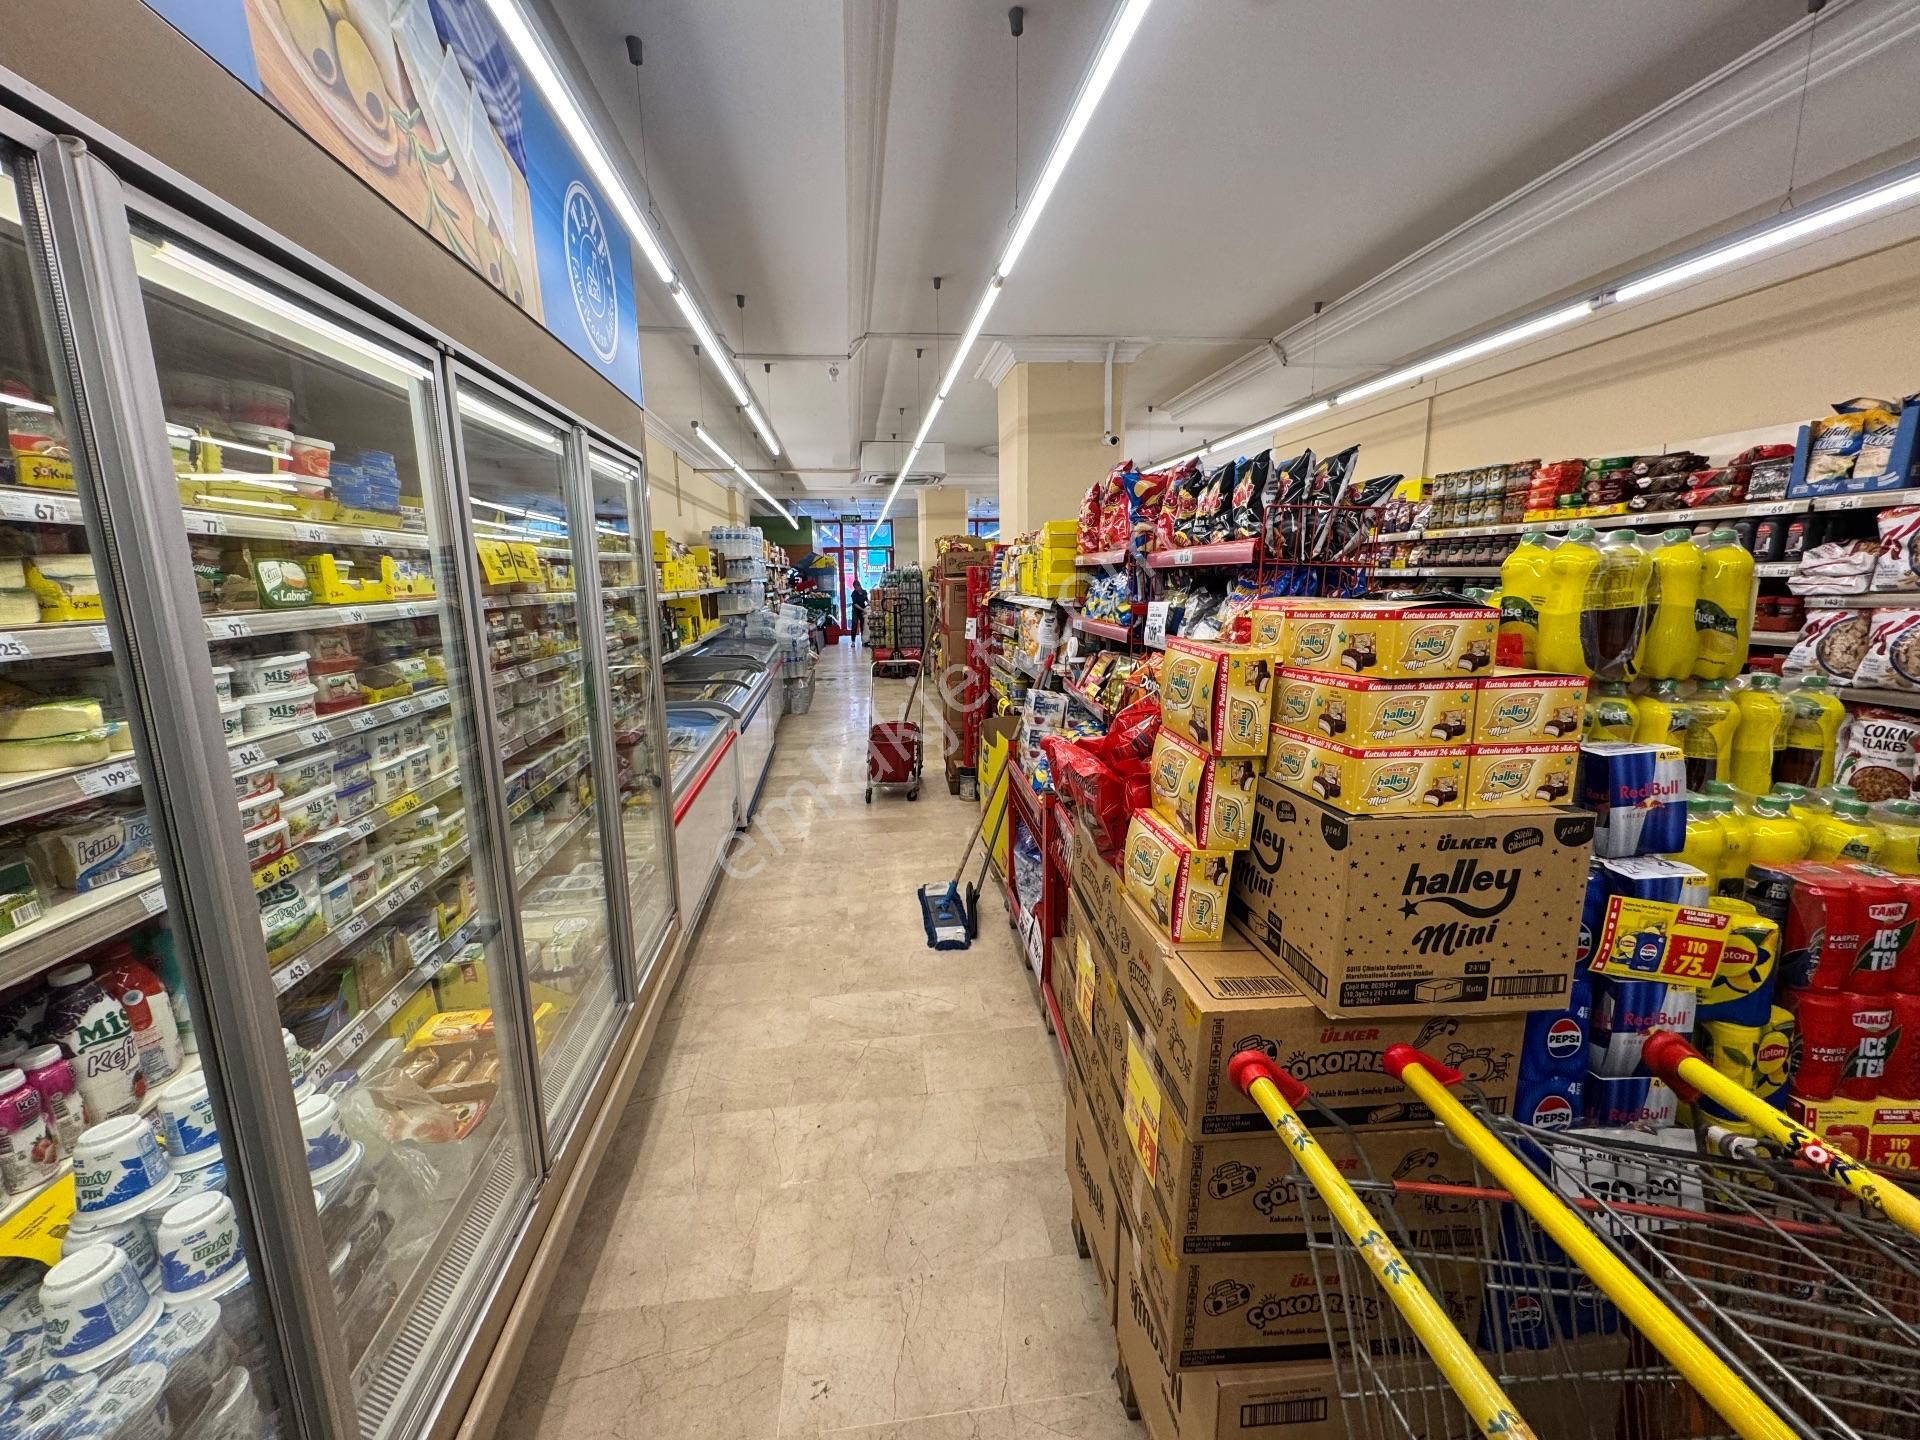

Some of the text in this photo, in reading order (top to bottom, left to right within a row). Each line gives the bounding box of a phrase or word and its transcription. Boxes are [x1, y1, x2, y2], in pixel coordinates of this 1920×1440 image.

[1771, 506, 1783, 514] 69
[1840, 501, 1853, 509] 54
[34, 504, 54, 520] 67
[203, 520, 216, 533] 77
[309, 529, 322, 541] 49
[193, 562, 219, 574] abne
[280, 590, 305, 602] Labne
[351, 611, 362, 621] 39
[1500, 608, 1521, 617] use
[1695, 612, 1714, 624] fuse
[228, 624, 244, 636] 97
[0, 644, 21, 656] 25
[1300, 635, 1324, 654] halley
[1415, 638, 1446, 656] halley
[1383, 708, 1417, 726] halley
[1499, 705, 1531, 722] halley
[312, 731, 326, 743] 84
[1863, 724, 1914, 742] CORN
[1862, 737, 1907, 752] FLAKES
[240, 752, 256, 765] 84
[1660, 752, 1666, 760] 4
[101, 774, 126, 787] 199
[1377, 774, 1410, 792] halley
[1491, 771, 1522, 788] halley
[1620, 780, 1678, 799] Red Bull
[1257, 794, 1274, 812] KER
[359, 823, 370, 833] 110
[1560, 822, 1586, 839] yeni
[1251, 812, 1285, 874] lley
[1437, 834, 1498, 851] ÜLKER
[78, 834, 119, 865] İçim
[279, 864, 289, 876] 62
[410, 881, 420, 891] 99
[1402, 858, 1522, 918] halley
[1686, 878, 1692, 886] 4
[388, 900, 399, 910] 86
[350, 922, 362, 933] 125
[1412, 918, 1500, 956] Mini
[1874, 929, 1900, 949] ICE
[1722, 952, 1750, 964] pton
[1870, 951, 1897, 971] TEA
[431, 960, 440, 970] 10
[289, 967, 305, 981] 43
[392, 1000, 398, 1008] 9
[1578, 1006, 1585, 1018] 4
[1624, 1012, 1686, 1025] Red Bull
[1854, 1012, 1891, 1027] TAMEK
[352, 1034, 364, 1046] 29
[1320, 1027, 1380, 1044] ÜLKER
[1549, 1034, 1580, 1044] PEPSI
[1860, 1038, 1887, 1056] ICE
[88, 1036, 136, 1078] Kefi
[1760, 1048, 1784, 1060] Lipton
[316, 1064, 328, 1078] 22
[1288, 1050, 1384, 1081] OKOPRE
[1856, 1059, 1885, 1078] TEA
[1568, 1083, 1576, 1094] 4
[1535, 1113, 1570, 1124] PEPSI
[1640, 1107, 1668, 1120] Bull
[1890, 1138, 1910, 1150] 119
[1884, 1152, 1911, 1170] 70
